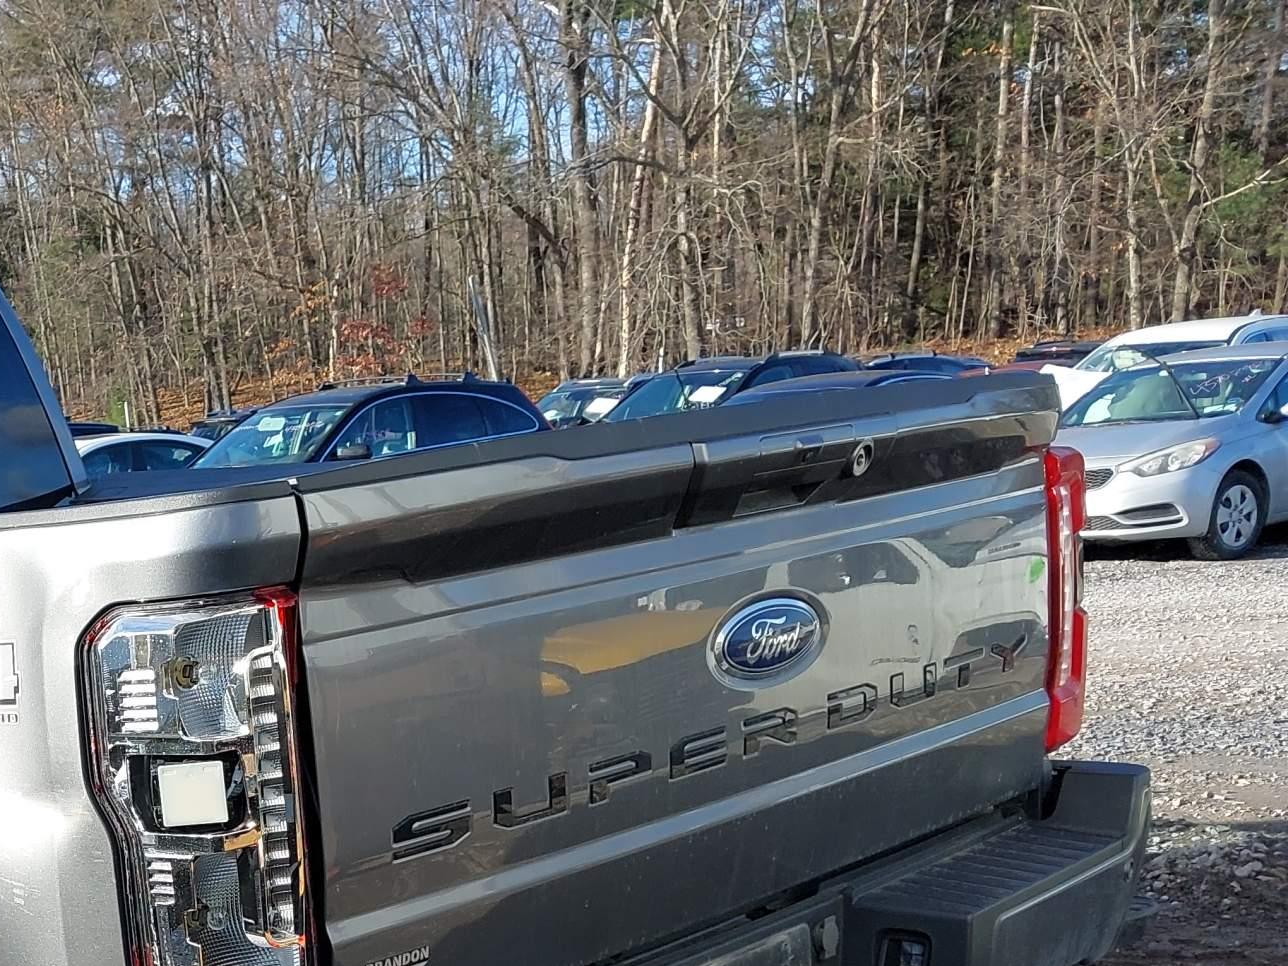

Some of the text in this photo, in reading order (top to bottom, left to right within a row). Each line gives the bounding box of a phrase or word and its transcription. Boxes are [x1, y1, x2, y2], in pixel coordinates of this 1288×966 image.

[746, 616, 801, 664] Ford
[391, 633, 1028, 865] SUPER DUTY
